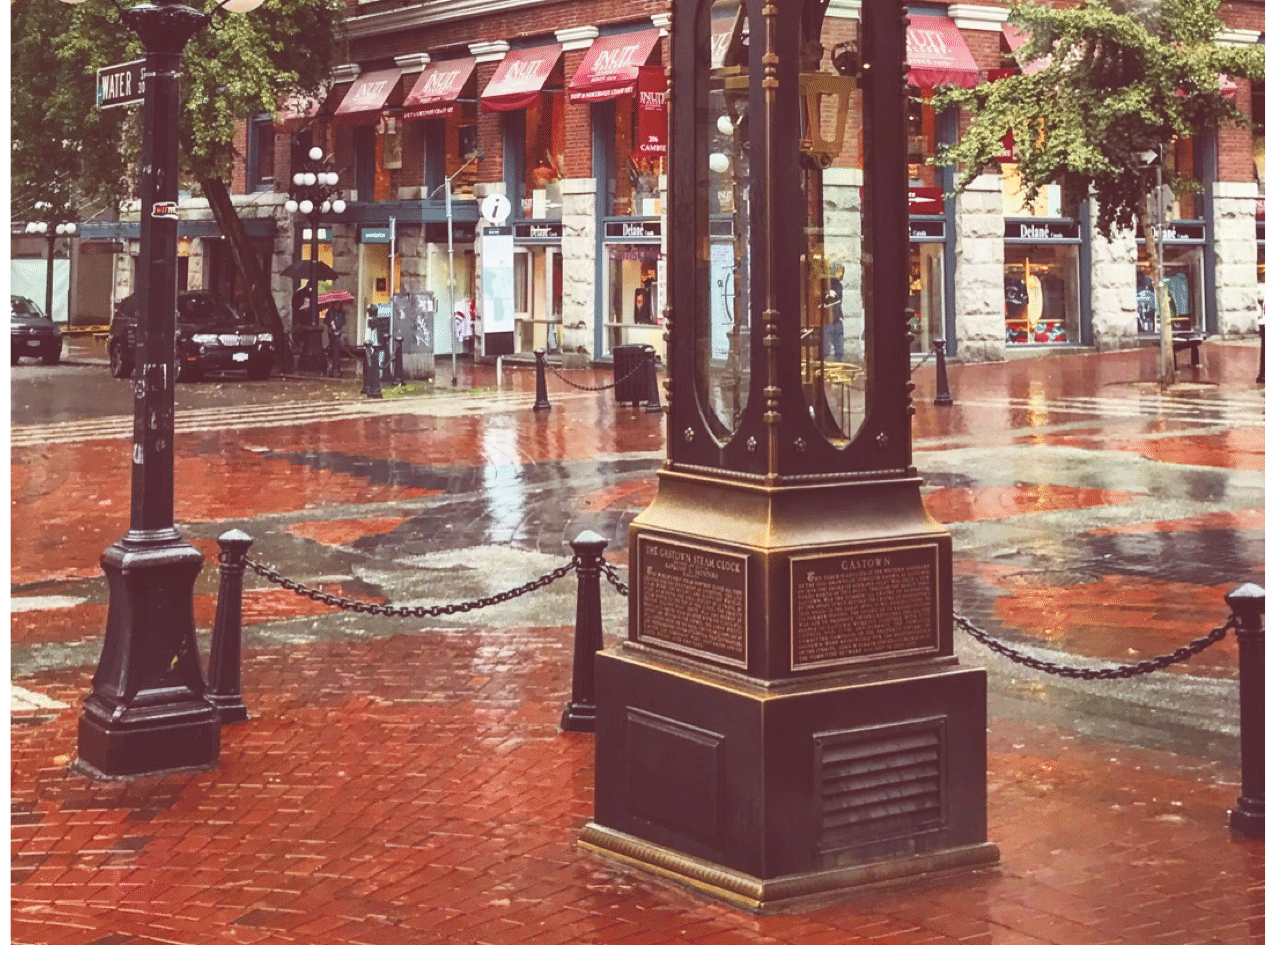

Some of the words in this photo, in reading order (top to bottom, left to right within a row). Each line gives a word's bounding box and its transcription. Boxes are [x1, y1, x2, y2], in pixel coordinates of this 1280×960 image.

[102, 70, 132, 100] WATER
[1019, 223, 1050, 238] Delané
[646, 545, 659, 556] THE
[659, 548, 691, 563] GASTOWN
[693, 555, 714, 568] STEAM
[716, 560, 741, 573] CLOCK
[841, 557, 891, 571] GASTOWN
